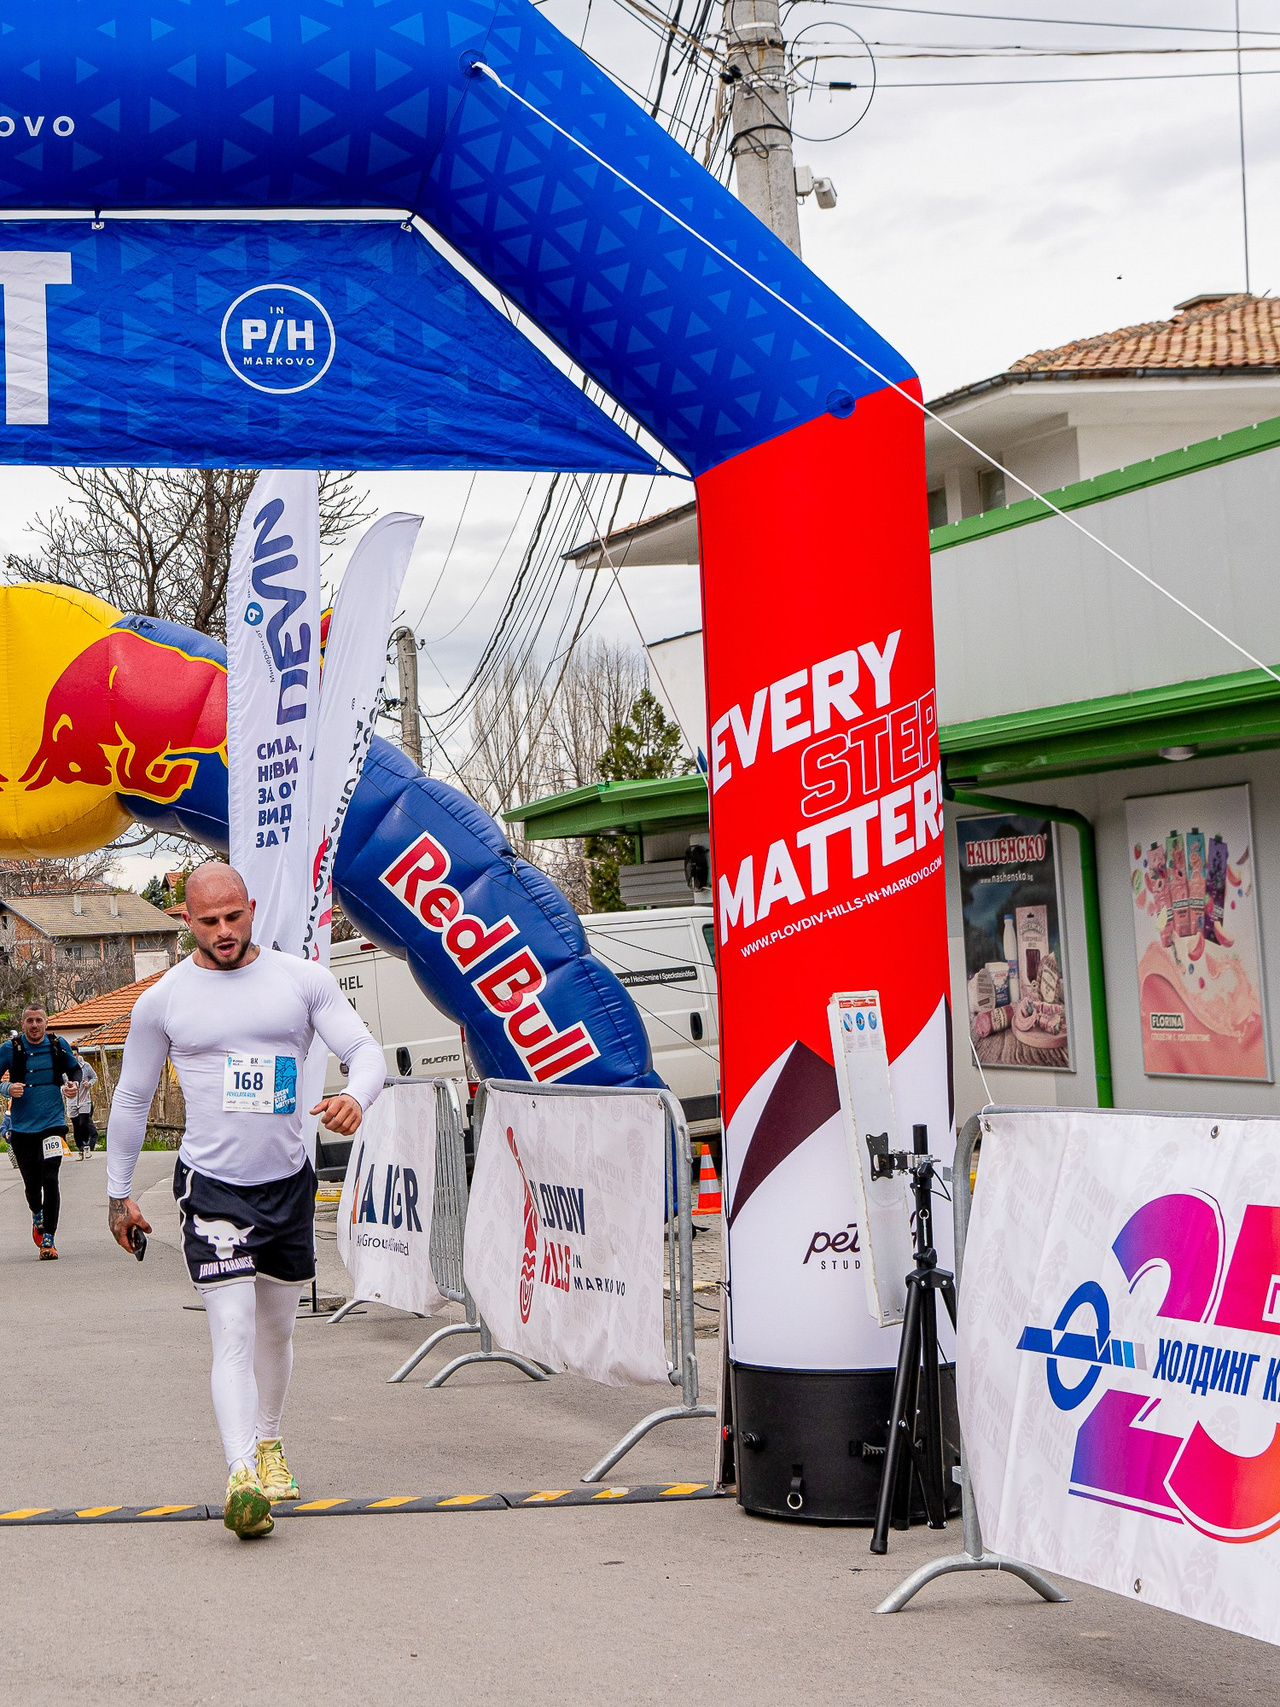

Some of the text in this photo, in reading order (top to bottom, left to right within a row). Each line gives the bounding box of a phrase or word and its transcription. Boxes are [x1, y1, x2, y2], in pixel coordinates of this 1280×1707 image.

[270, 306, 284, 315] IN
[242, 319, 315, 354] P/H
[243, 356, 315, 366] MARKOVO
[250, 497, 312, 726] DEVIN
[711, 629, 902, 796] EVERY
[801, 688, 937, 818] STEP
[255, 830, 280, 848] ЗА
[965, 834, 1046, 867] НАШЕНСКО
[740, 855, 943, 958] WWW.PLOVDIV-HILLS-IN-MARKOVO.COM
[384, 836, 595, 1083] Red Bull
[337, 975, 363, 990] HEL
[1151, 1014, 1184, 1029] FLORINA
[421, 1054, 460, 1065] DUCATO
[234, 1071, 263, 1090] 168
[199, 1262, 220, 1279] IRON
[573, 1254, 582, 1269] IN
[821, 1260, 860, 1270] STUD
[573, 1276, 626, 1296] MARKOVO
[1152, 1338, 1280, 1403] ХОЛДИНГ К
